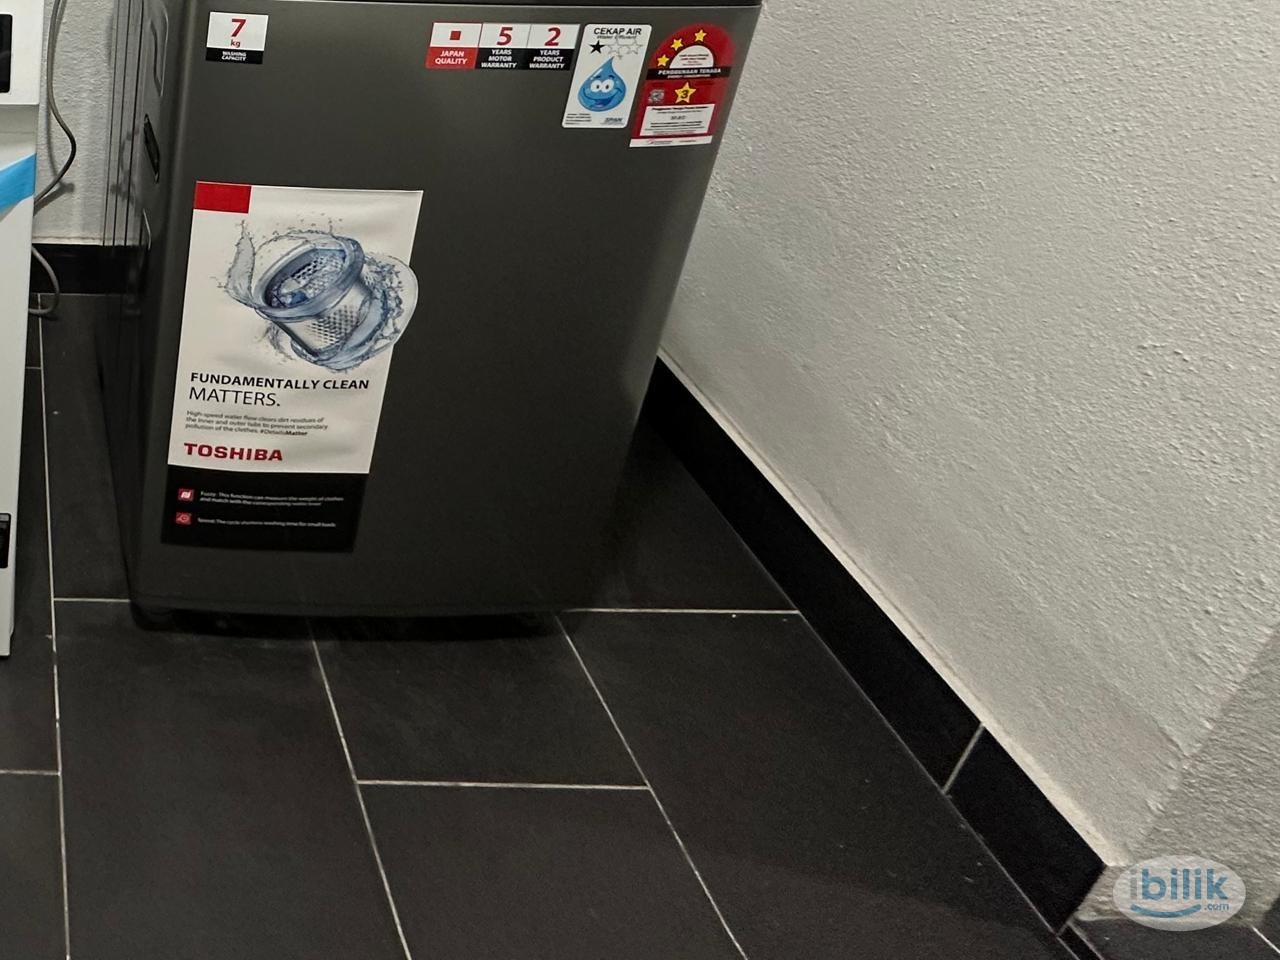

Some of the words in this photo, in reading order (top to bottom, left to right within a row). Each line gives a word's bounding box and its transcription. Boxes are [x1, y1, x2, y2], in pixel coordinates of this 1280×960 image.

[232, 19, 246, 37] 7
[497, 27, 512, 45] 5
[544, 28, 560, 46] 2
[231, 39, 240, 48] kg
[681, 90, 688, 98] 3
[190, 373, 320, 389] FUNDAMENTALLY
[323, 380, 369, 389] CLEAN
[189, 387, 280, 407] MATTERS.
[184, 443, 283, 461] TOSHIBA
